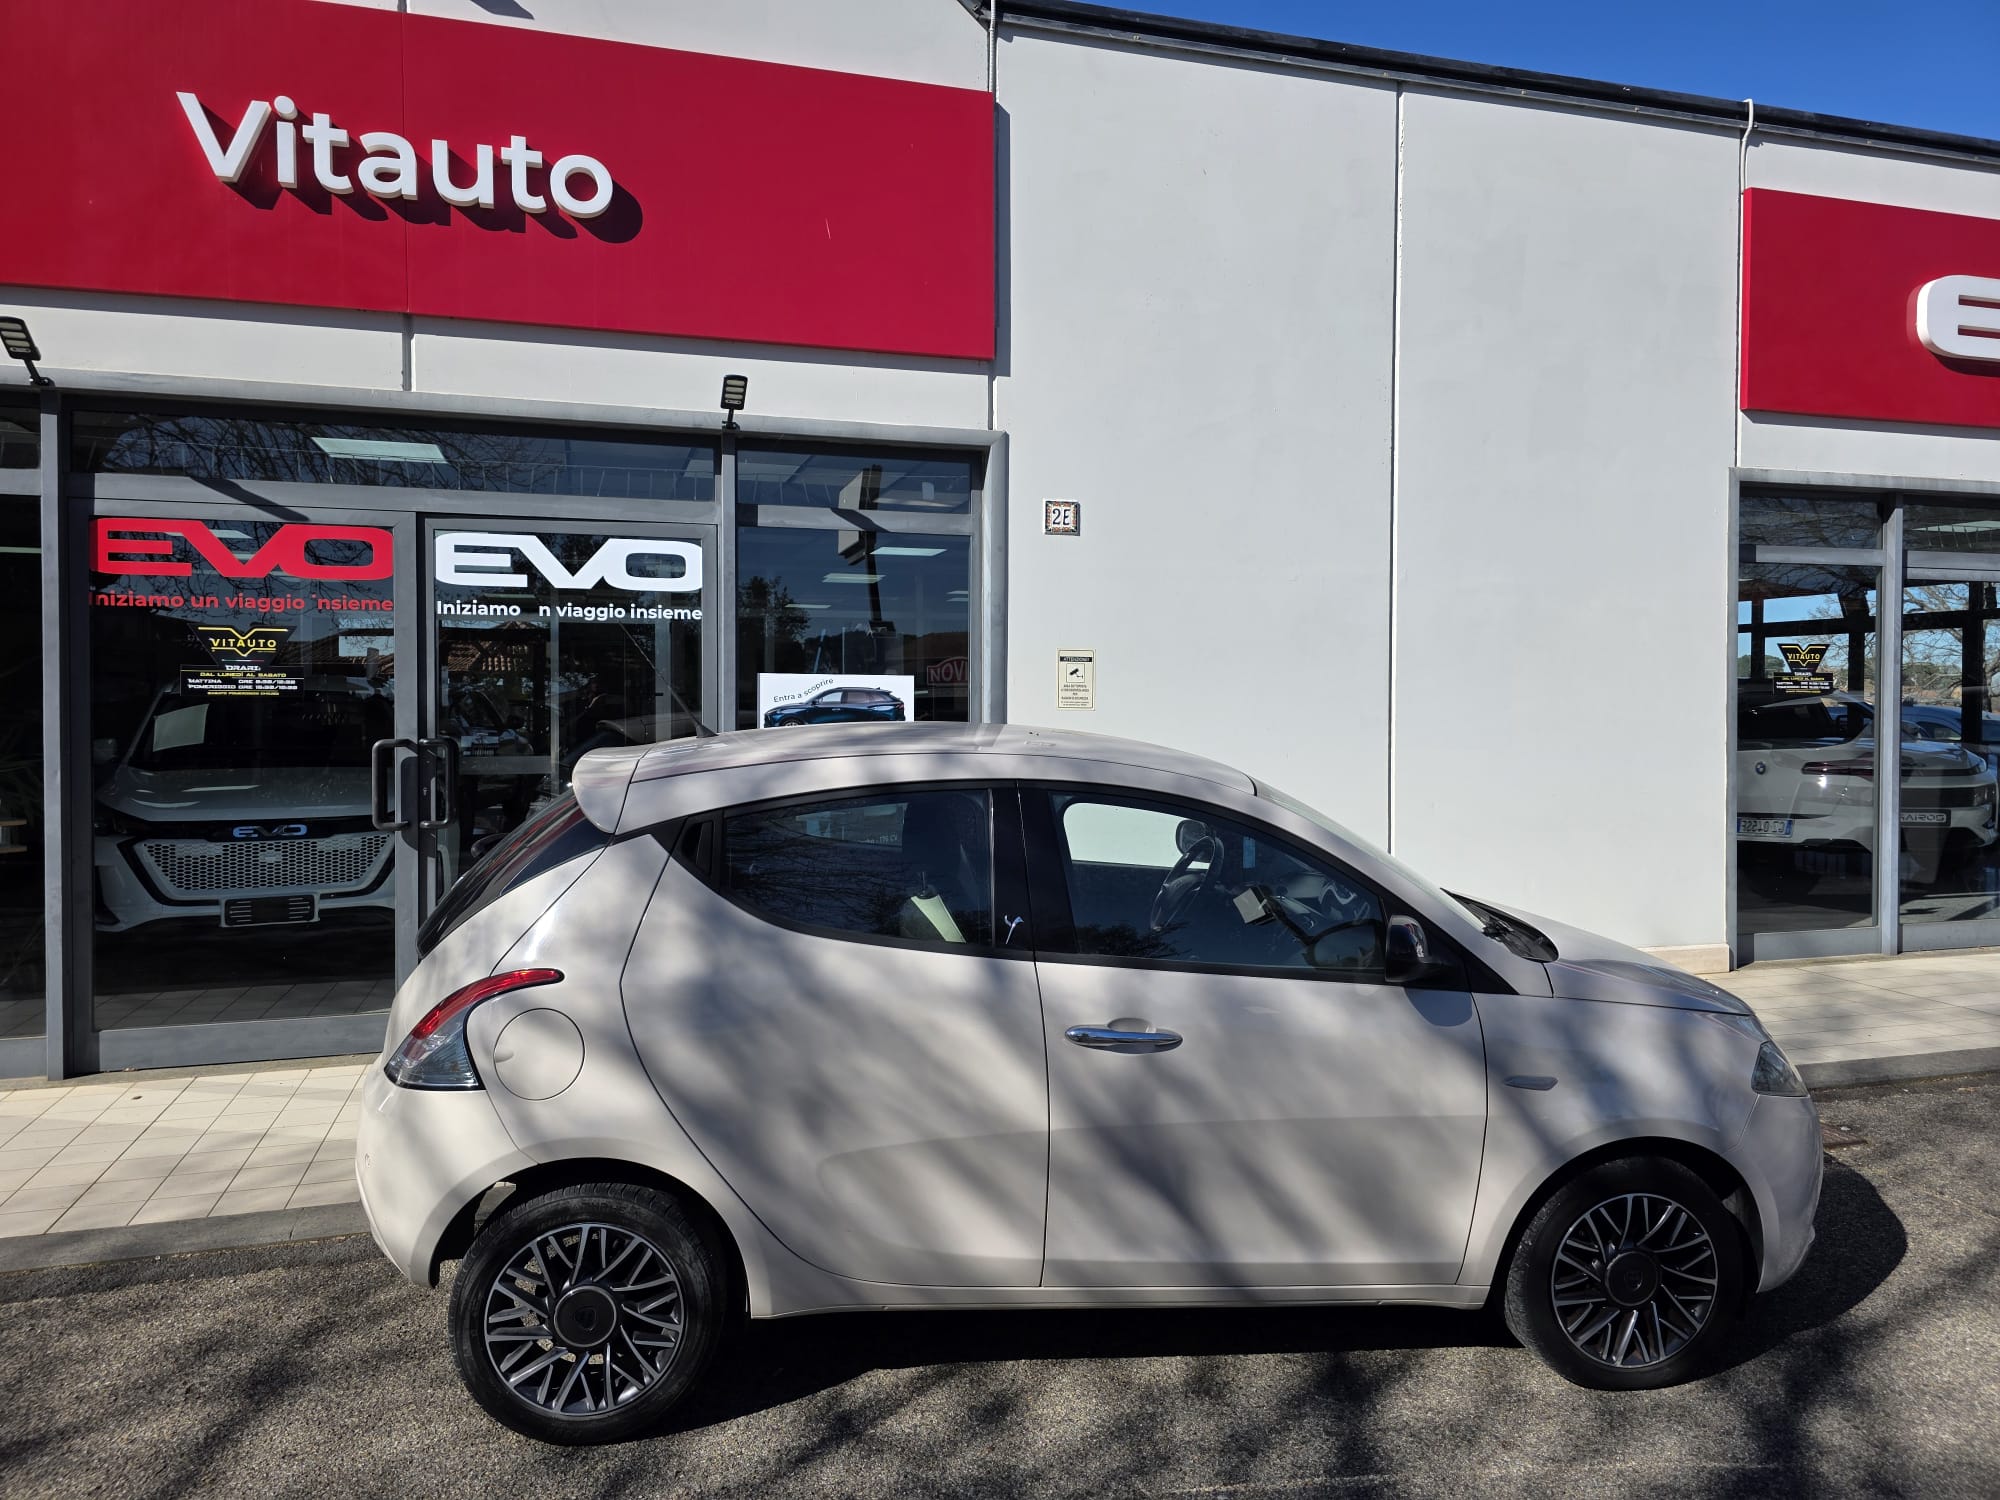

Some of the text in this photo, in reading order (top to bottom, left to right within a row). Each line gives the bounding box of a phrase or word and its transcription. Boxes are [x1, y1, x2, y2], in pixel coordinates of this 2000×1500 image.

[175, 91, 614, 218] Vitauto
[1052, 508, 1071, 526] 2E
[89, 517, 394, 581] EVO
[435, 532, 703, 592] EVO
[190, 595, 219, 608] un
[225, 592, 305, 612] viaggio
[312, 593, 394, 611] nsieme
[436, 600, 521, 618] Iniziamo
[556, 602, 626, 621] viaggio
[630, 603, 703, 620] insieme
[209, 638, 277, 648] VITAUTO
[773, 694, 796, 703] Entra
[803, 678, 834, 696] scoprire
[232, 823, 308, 838] EVO
